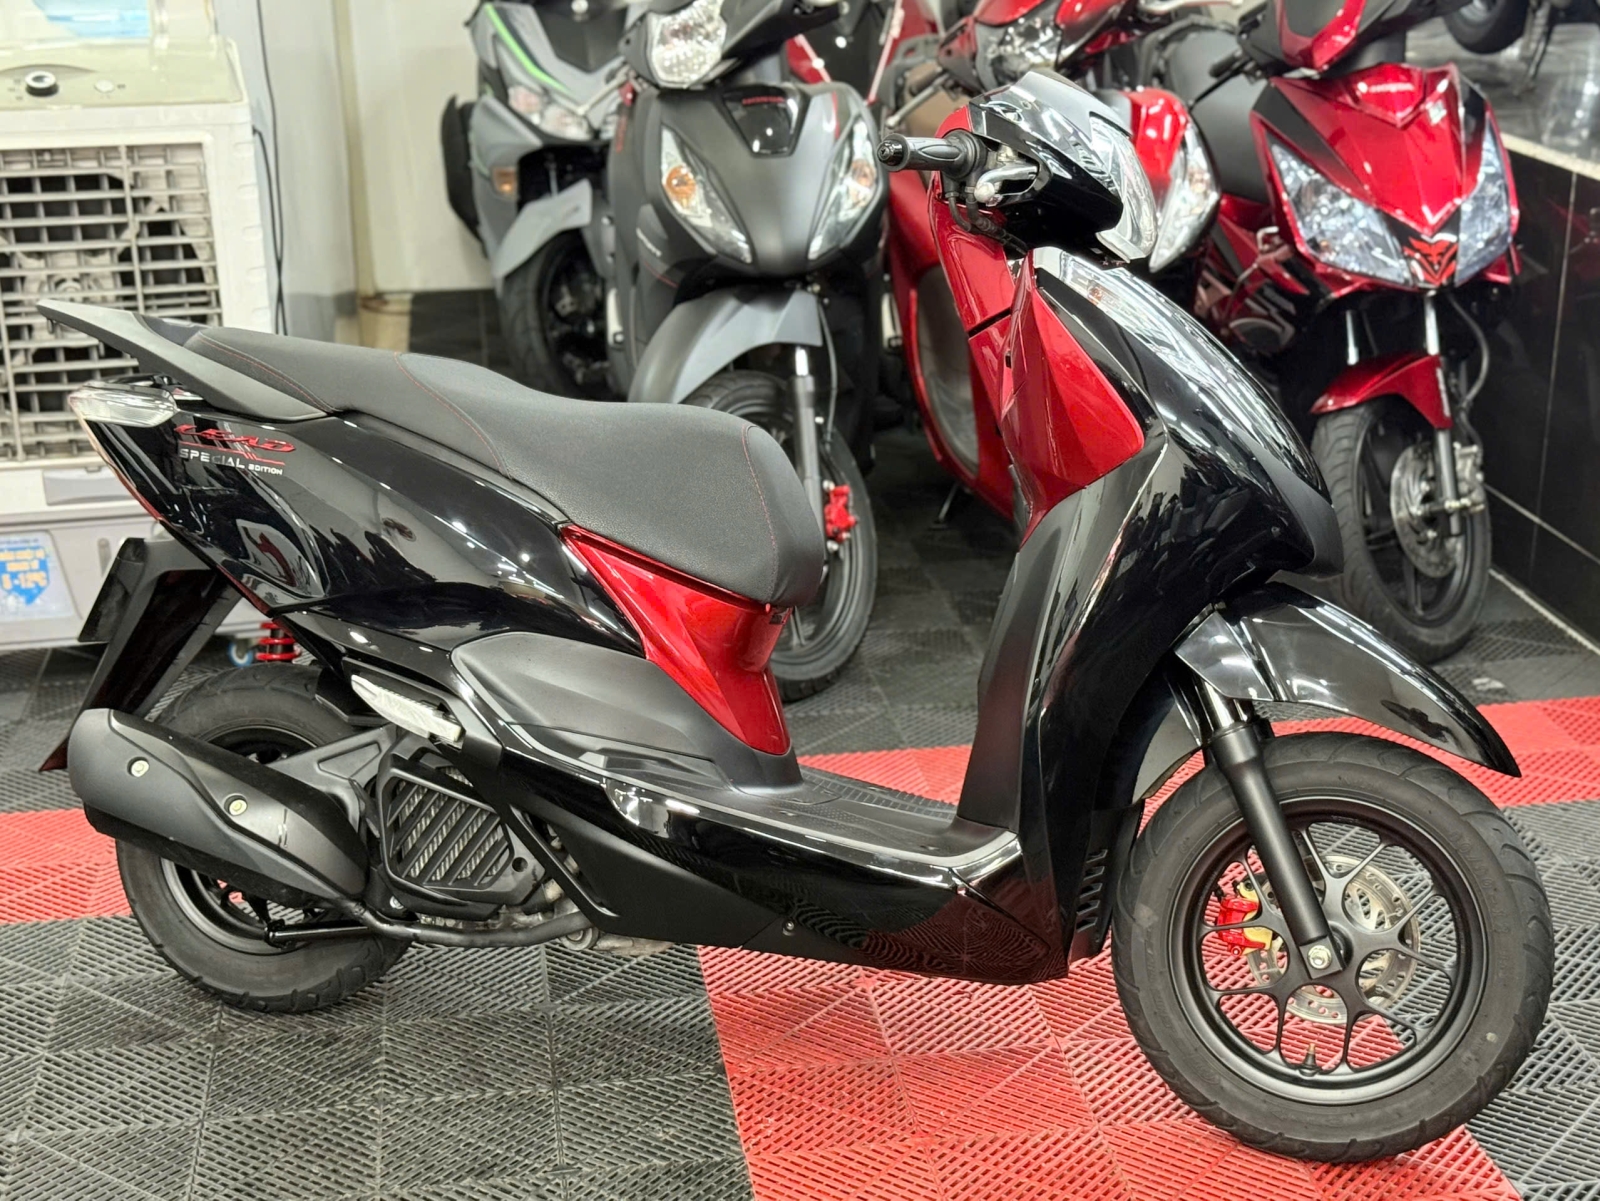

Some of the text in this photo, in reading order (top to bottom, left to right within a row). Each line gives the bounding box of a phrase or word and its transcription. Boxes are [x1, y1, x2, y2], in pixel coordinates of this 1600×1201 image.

[174, 424, 296, 452] LEAD
[179, 448, 284, 476] SPECIAL EDITION
